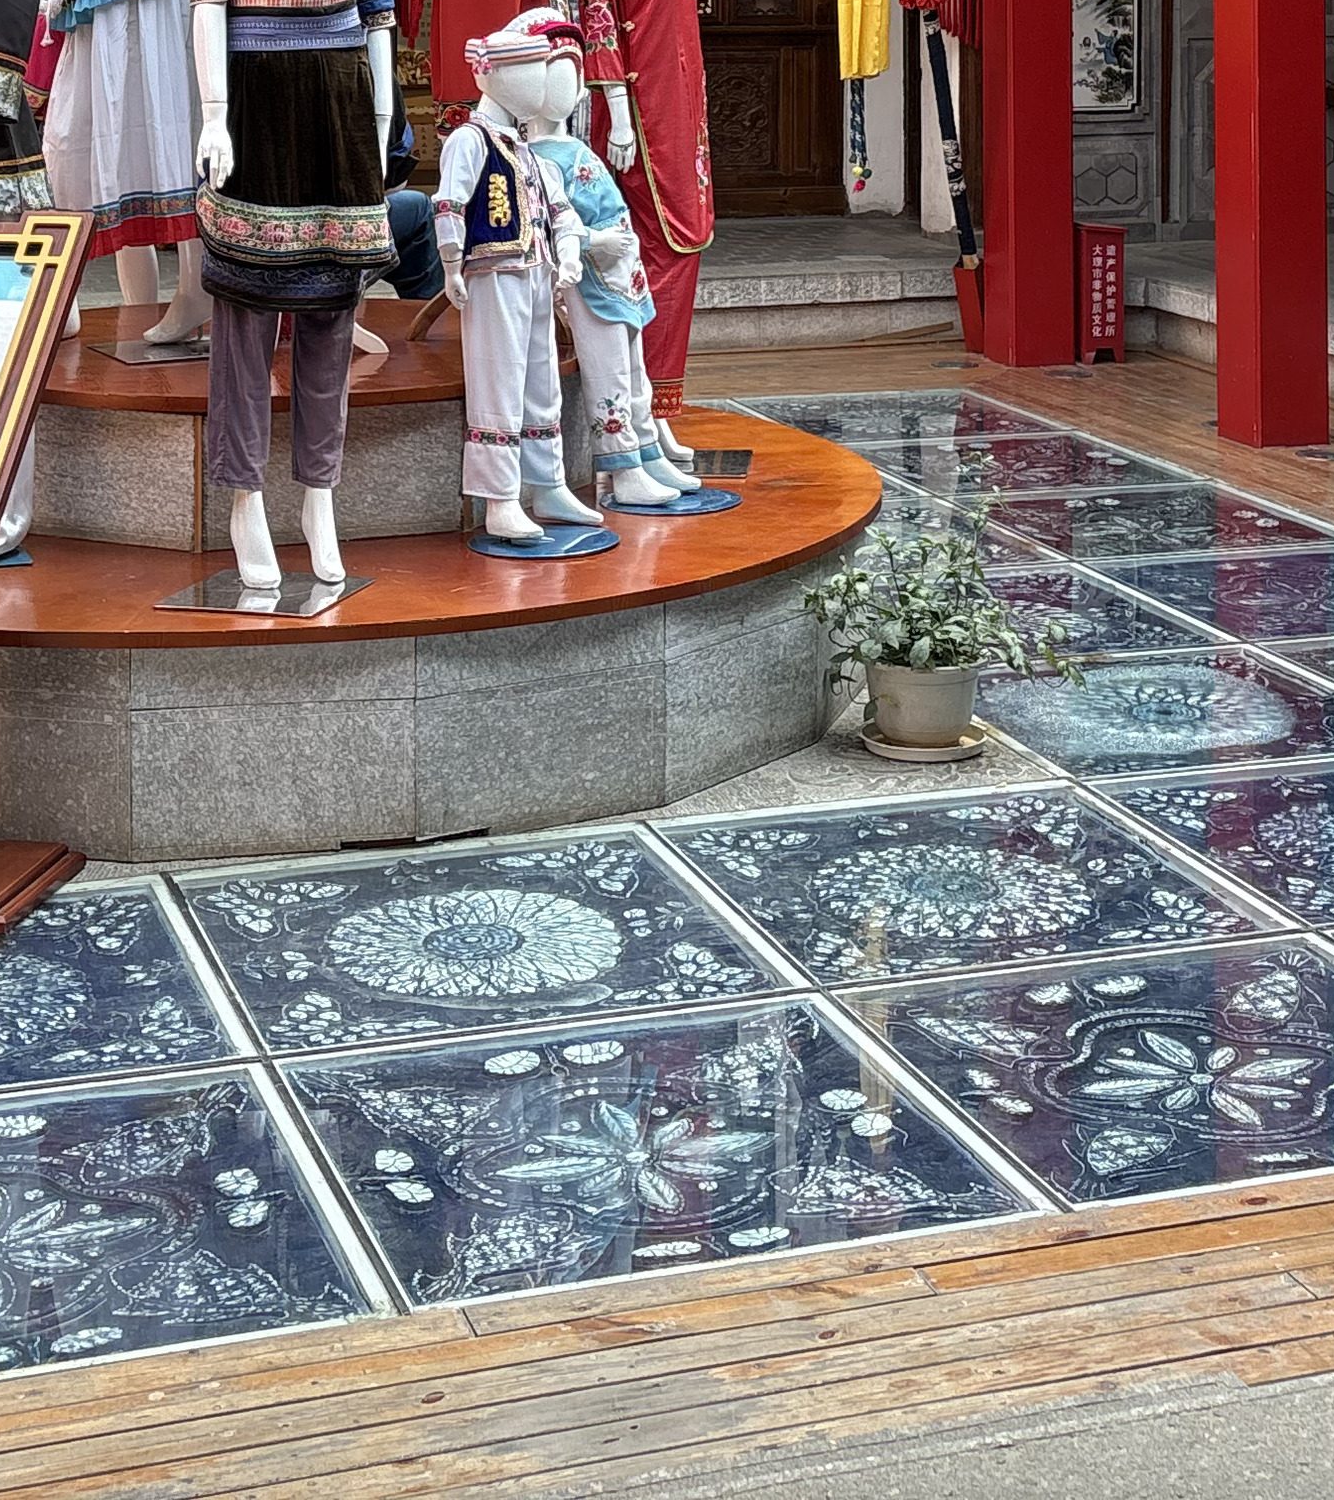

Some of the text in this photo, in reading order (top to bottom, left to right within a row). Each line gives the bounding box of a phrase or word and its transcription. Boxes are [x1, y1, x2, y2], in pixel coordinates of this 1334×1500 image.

[1091, 244, 1103, 338] 大理市非物质文化
[1105, 245, 1117, 337] 遗产保护管理所
